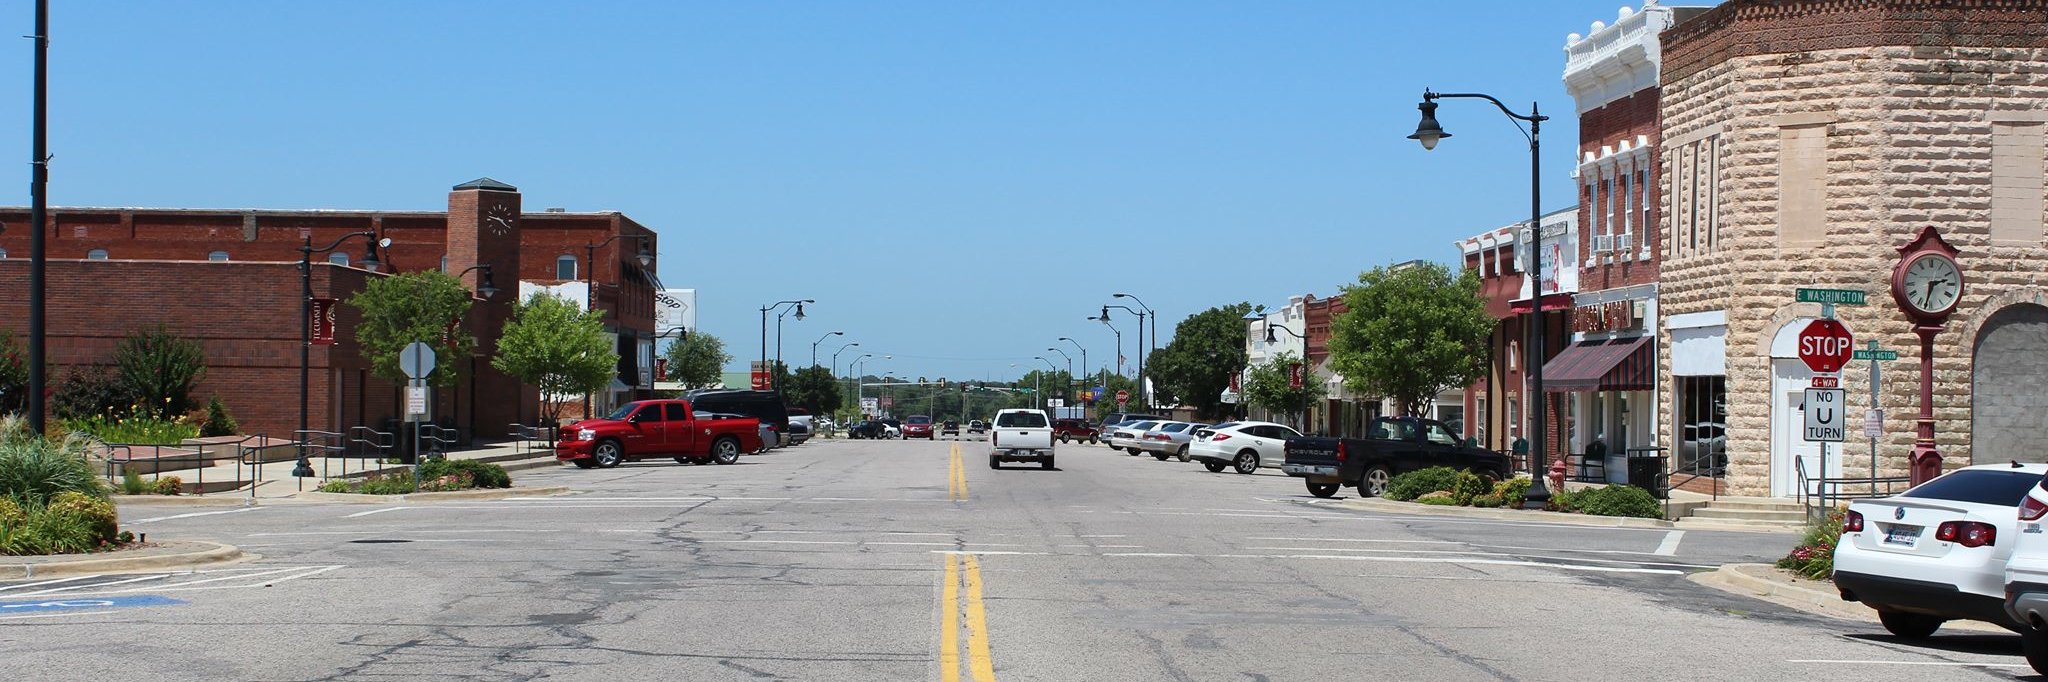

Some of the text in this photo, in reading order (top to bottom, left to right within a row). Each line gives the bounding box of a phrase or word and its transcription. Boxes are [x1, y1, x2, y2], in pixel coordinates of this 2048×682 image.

[655, 293, 681, 309] Stop
[1797, 290, 1863, 303] E WASHINGTON
[1802, 336, 1849, 356] STOP
[1857, 351, 1896, 359] WASNGTON
[1813, 379, 1837, 387] 4-WAY
[1816, 391, 1833, 403] NO
[1817, 408, 1832, 424] U
[1808, 427, 1841, 438] TURN
